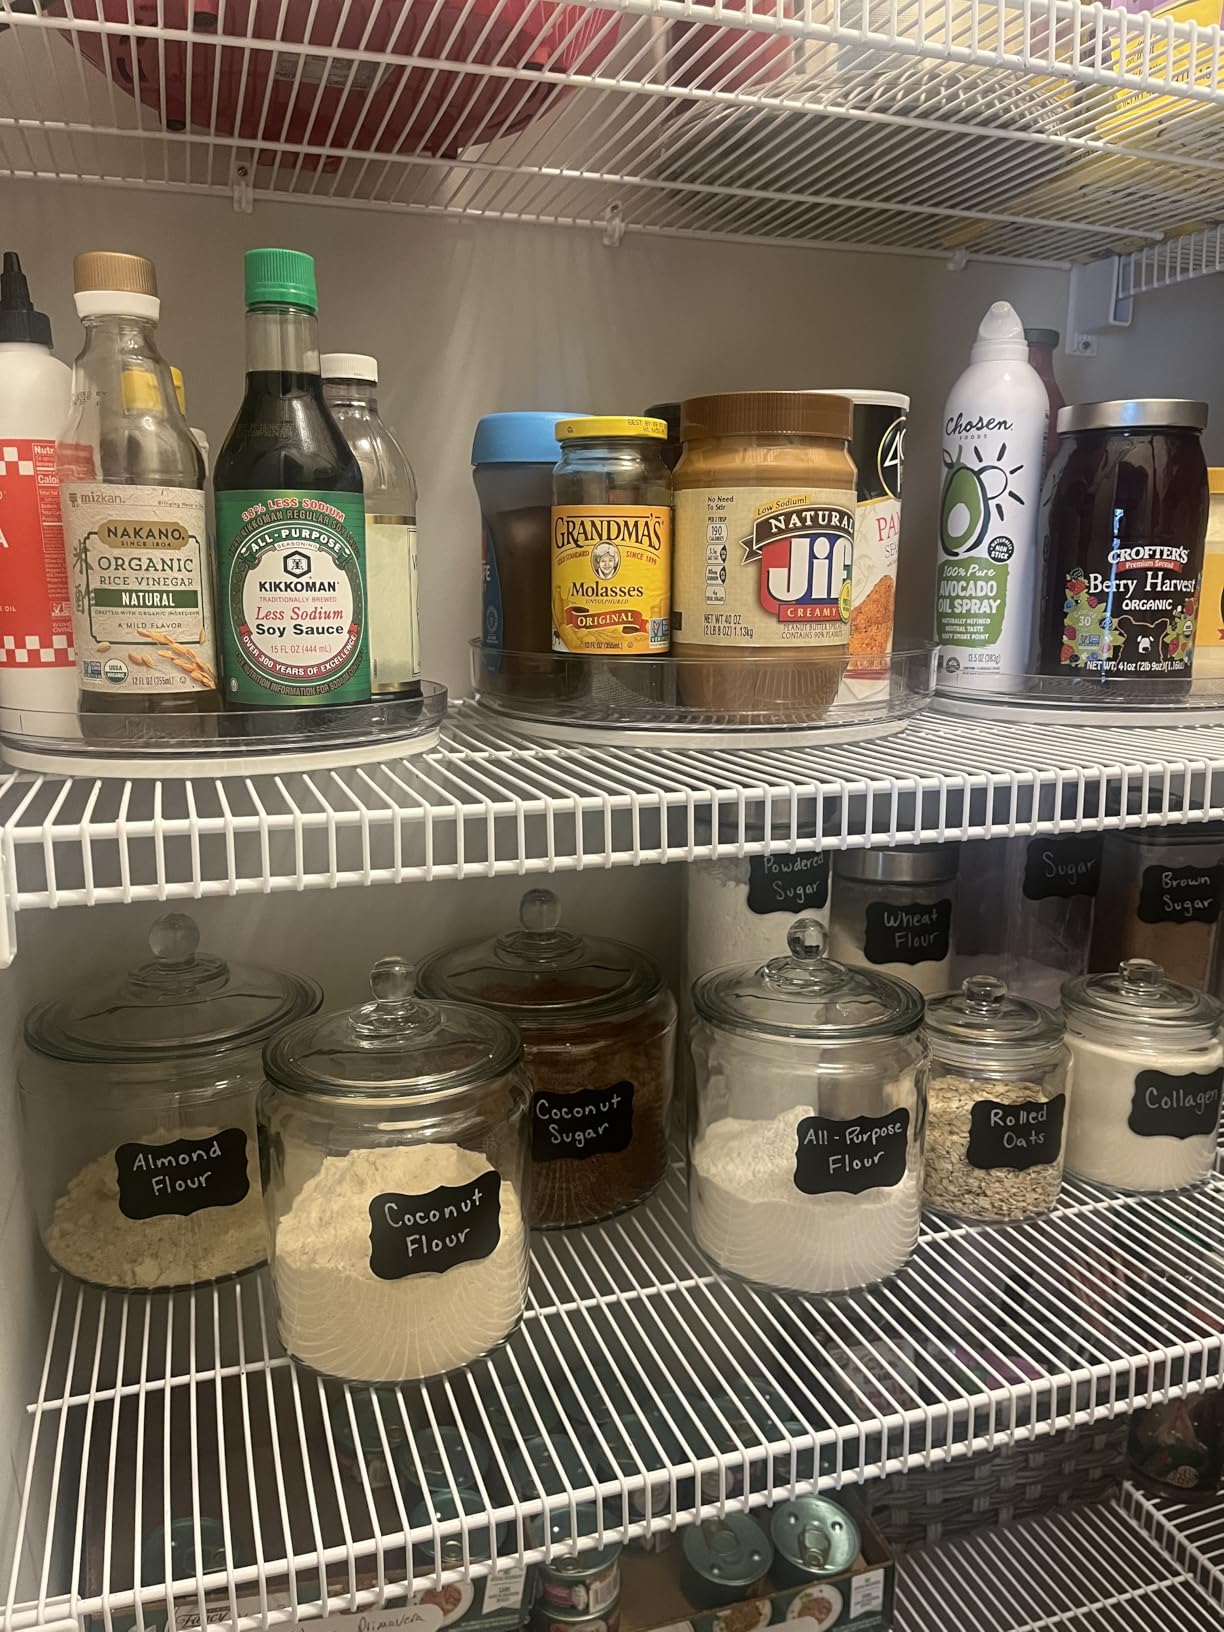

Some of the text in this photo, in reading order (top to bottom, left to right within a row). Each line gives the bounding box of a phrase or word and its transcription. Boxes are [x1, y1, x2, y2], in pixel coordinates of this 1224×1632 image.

[268, 498, 298, 510] LESS
[302, 500, 345, 522] SODIUM
[757, 496, 808, 516] Low Sodium!
[240, 510, 283, 537] KIKKOMAN
[288, 510, 330, 525] REGULAR
[712, 526, 722, 536] 190
[768, 511, 854, 533] NATURAL
[555, 513, 662, 550] GRANDMA'S
[98, 556, 194, 572] ORGANIC
[626, 551, 644, 560] SINCE
[991, 552, 1008, 560] STICK
[1108, 546, 1188, 564] CROFTER'S
[768, 537, 852, 601] Jif
[944, 564, 996, 577] 100% Pure
[100, 576, 194, 586] RICE VINEGAR
[259, 581, 336, 592] KIKKOMAN
[571, 582, 644, 598] Molasses
[939, 580, 997, 596] AVOCADO
[1088, 571, 1196, 599] Berry Harvest
[122, 592, 176, 606] NATURAL
[938, 598, 1001, 614] OIL SPRAY
[1122, 599, 1173, 610] ORGANIC
[256, 606, 343, 620] Less Sodium
[578, 613, 634, 626] ORIGINAL
[704, 614, 741, 624] NET WT 40 OZ
[788, 608, 836, 617] CREAMY
[256, 624, 343, 638] Soy Sauce
[710, 626, 716, 636] LB
[722, 626, 732, 637] OZ)
[734, 626, 753, 638] 1.13kg
[244, 636, 259, 657] OVER
[259, 655, 273, 668] 300
[276, 664, 304, 675] YEARS
[321, 635, 356, 672] EXCELLENCE
[271, 645, 279, 653] 15
[290, 645, 300, 653] OZ
[302, 645, 316, 654] (444
[1086, 661, 1102, 670] NET
[316, 686, 329, 694] FOR
[764, 855, 824, 874] Powdered
[1042, 851, 1096, 885] Sugar
[1162, 871, 1210, 889] Brown
[773, 881, 820, 904] Sugar
[1162, 895, 1213, 917] Sugar
[884, 908, 937, 927] Wheat
[895, 930, 939, 949] Flour
[536, 1094, 621, 1120] Coconut
[1146, 1087, 1218, 1115] Collagen
[990, 1108, 1047, 1127] Rolled
[549, 1123, 608, 1148] Sugar
[1002, 1130, 1046, 1148] Oats
[133, 1140, 222, 1171] Almond
[828, 1151, 884, 1174] Flour
[152, 1172, 212, 1196] Flour
[384, 1188, 482, 1228] Coconut
[406, 1228, 470, 1257] Flour
